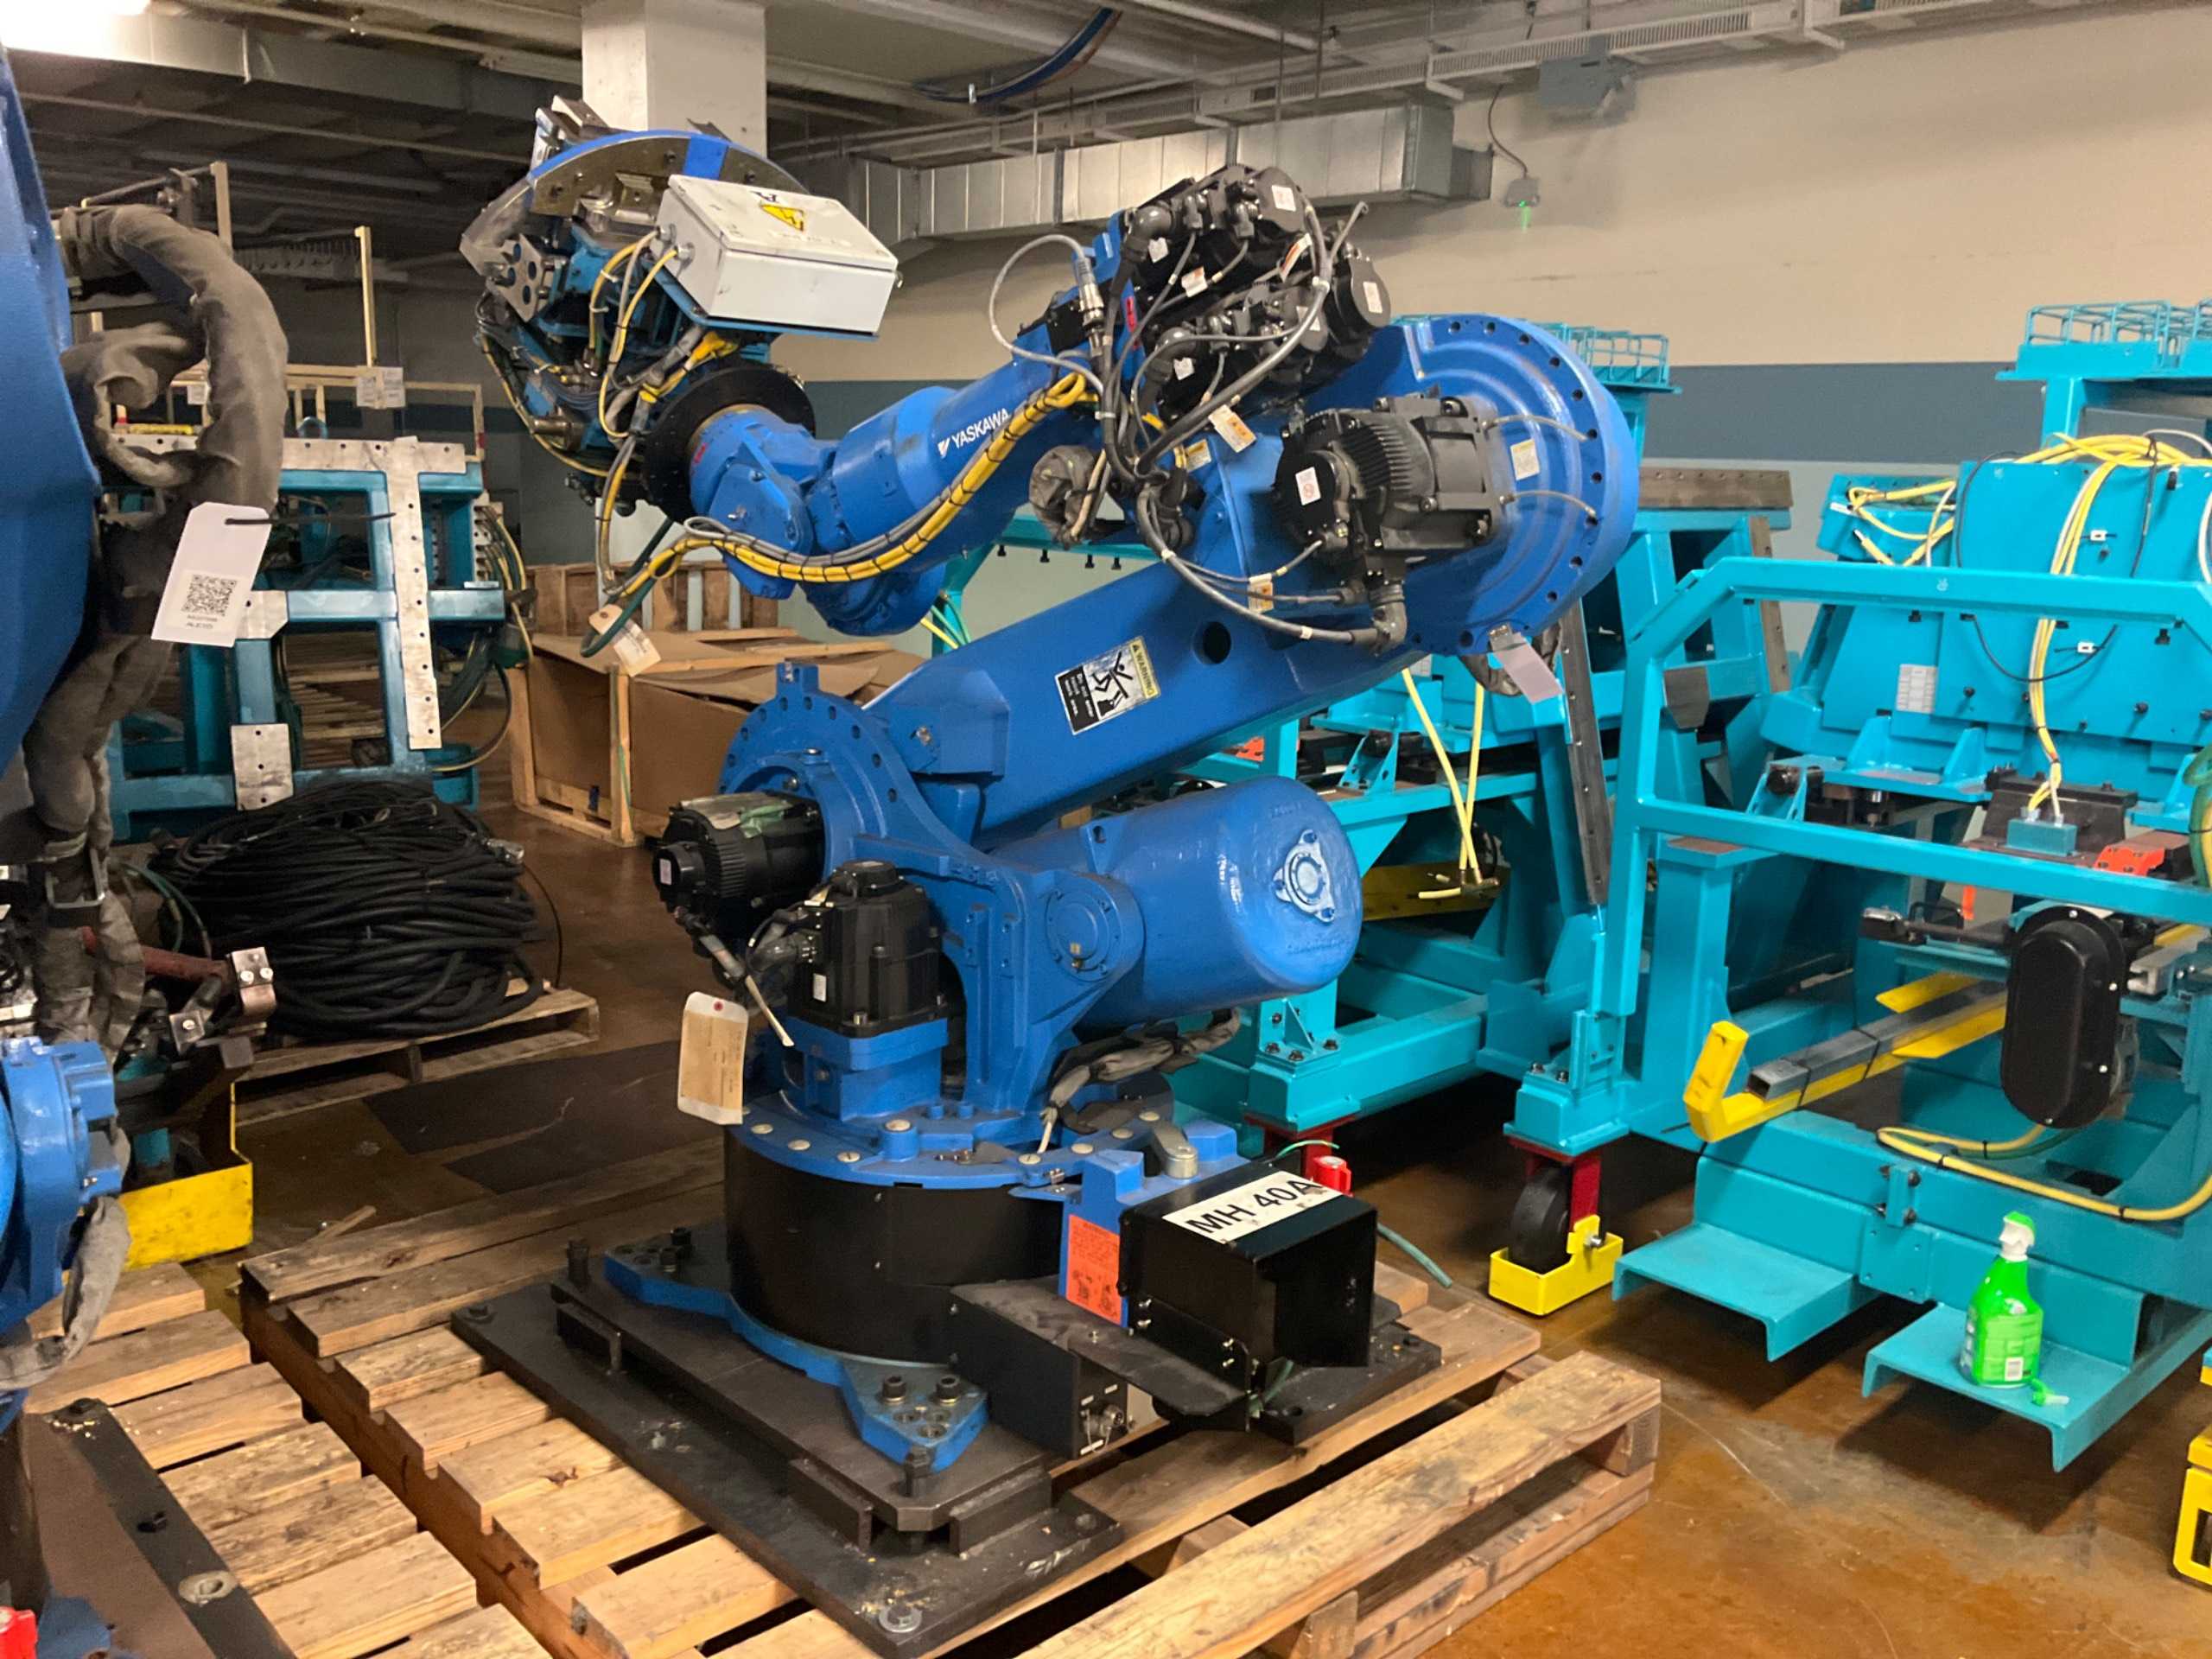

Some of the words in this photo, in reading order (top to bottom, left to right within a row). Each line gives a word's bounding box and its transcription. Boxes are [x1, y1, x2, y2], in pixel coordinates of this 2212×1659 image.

[951, 408, 1009, 448] YASKAWA
[1136, 652, 1155, 696] WARNING
[1185, 1204, 1256, 1234] MH
[1253, 1179, 1323, 1208] 40A
